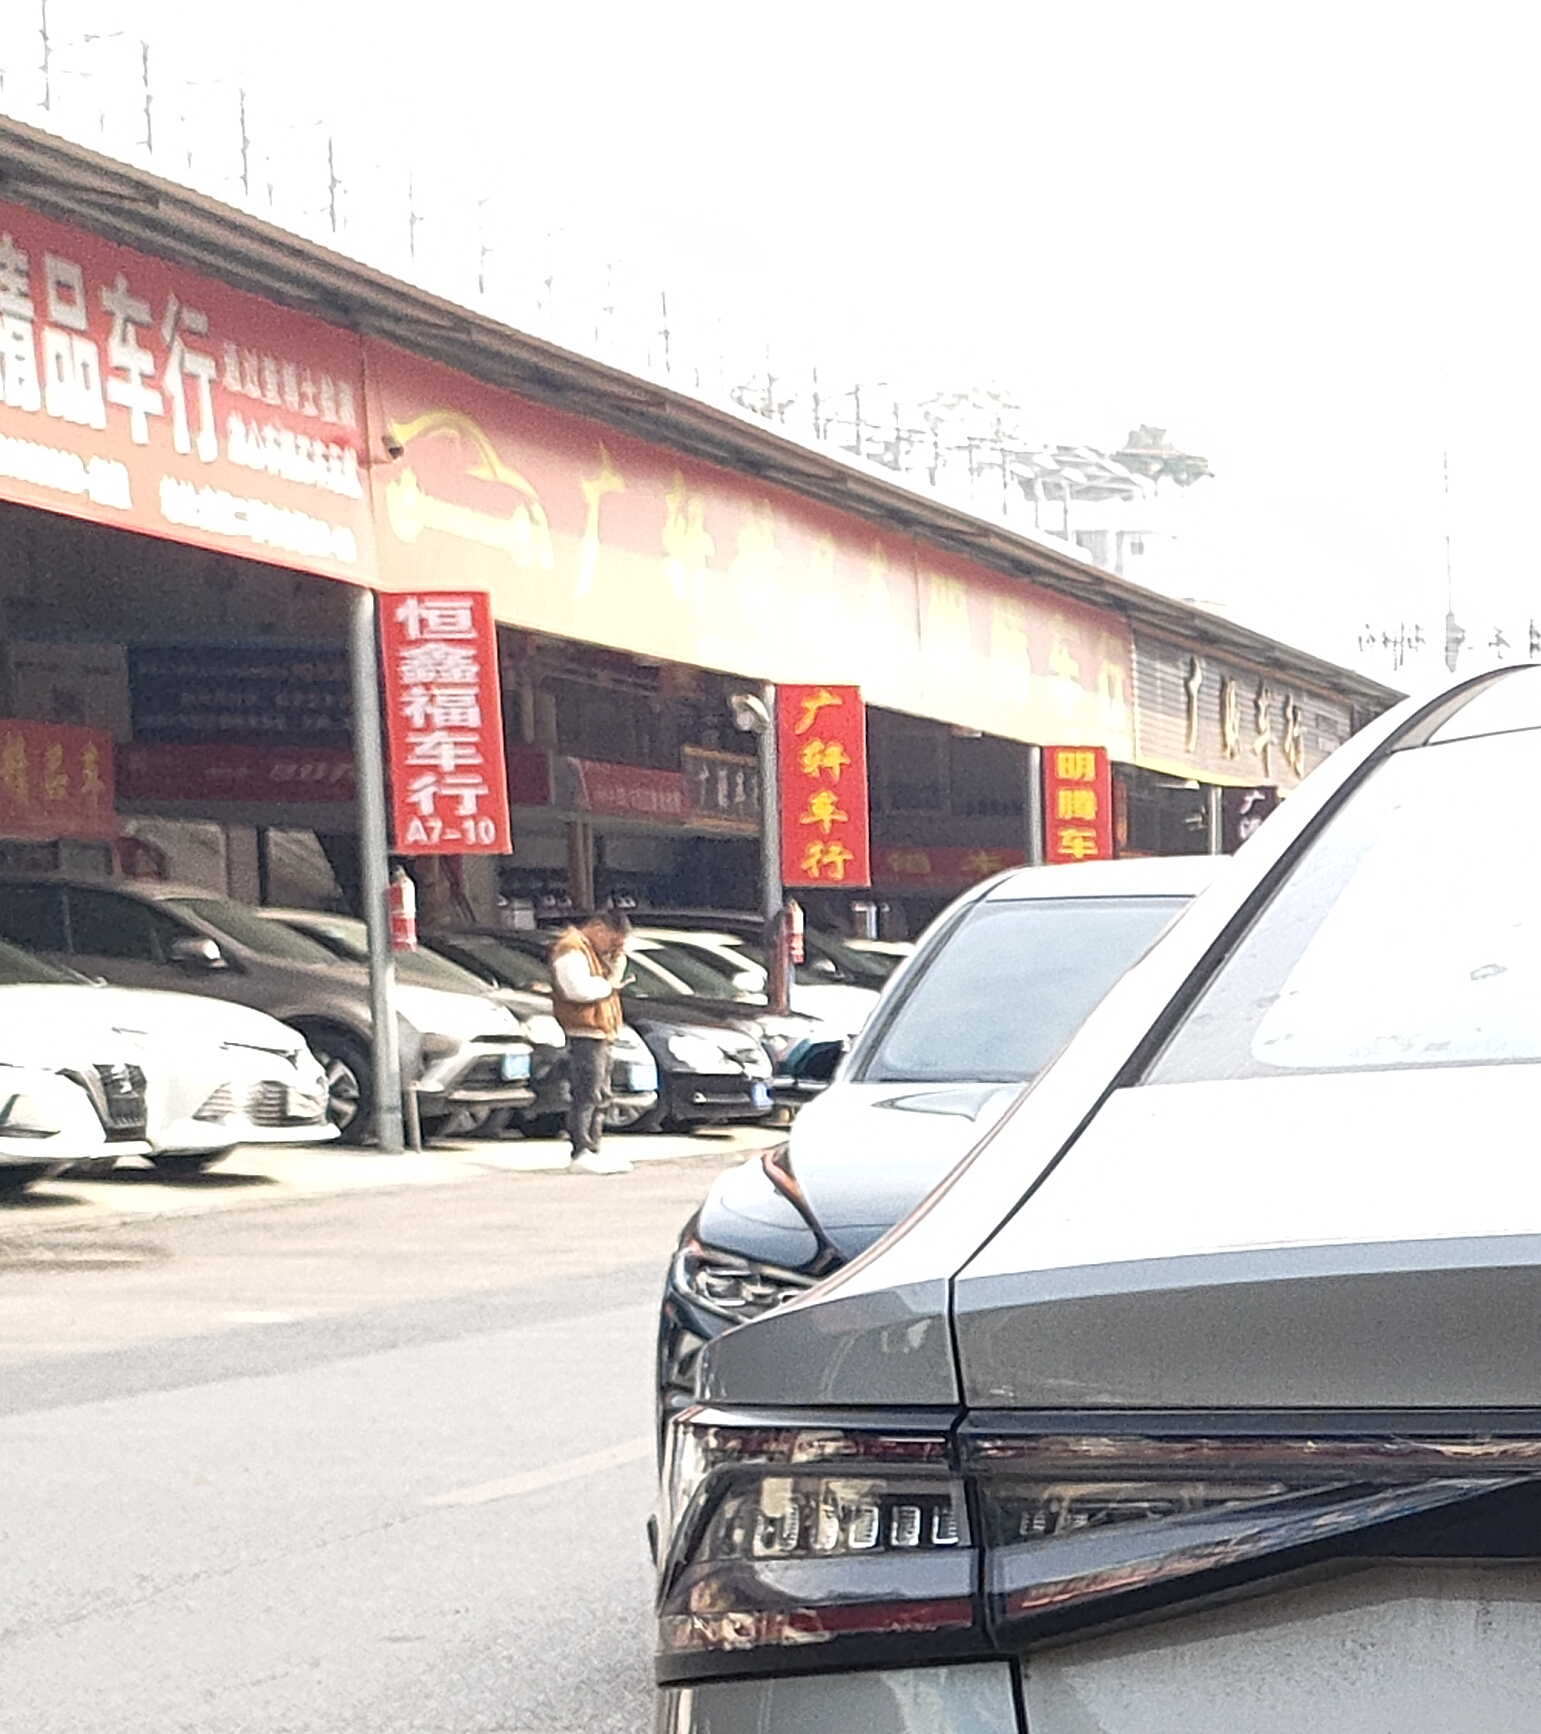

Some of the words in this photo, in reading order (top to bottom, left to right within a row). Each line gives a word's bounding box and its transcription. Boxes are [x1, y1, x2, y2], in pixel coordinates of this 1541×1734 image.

[394, 596, 490, 817] 恒鑫福车行
[404, 815, 496, 846] A7-10
